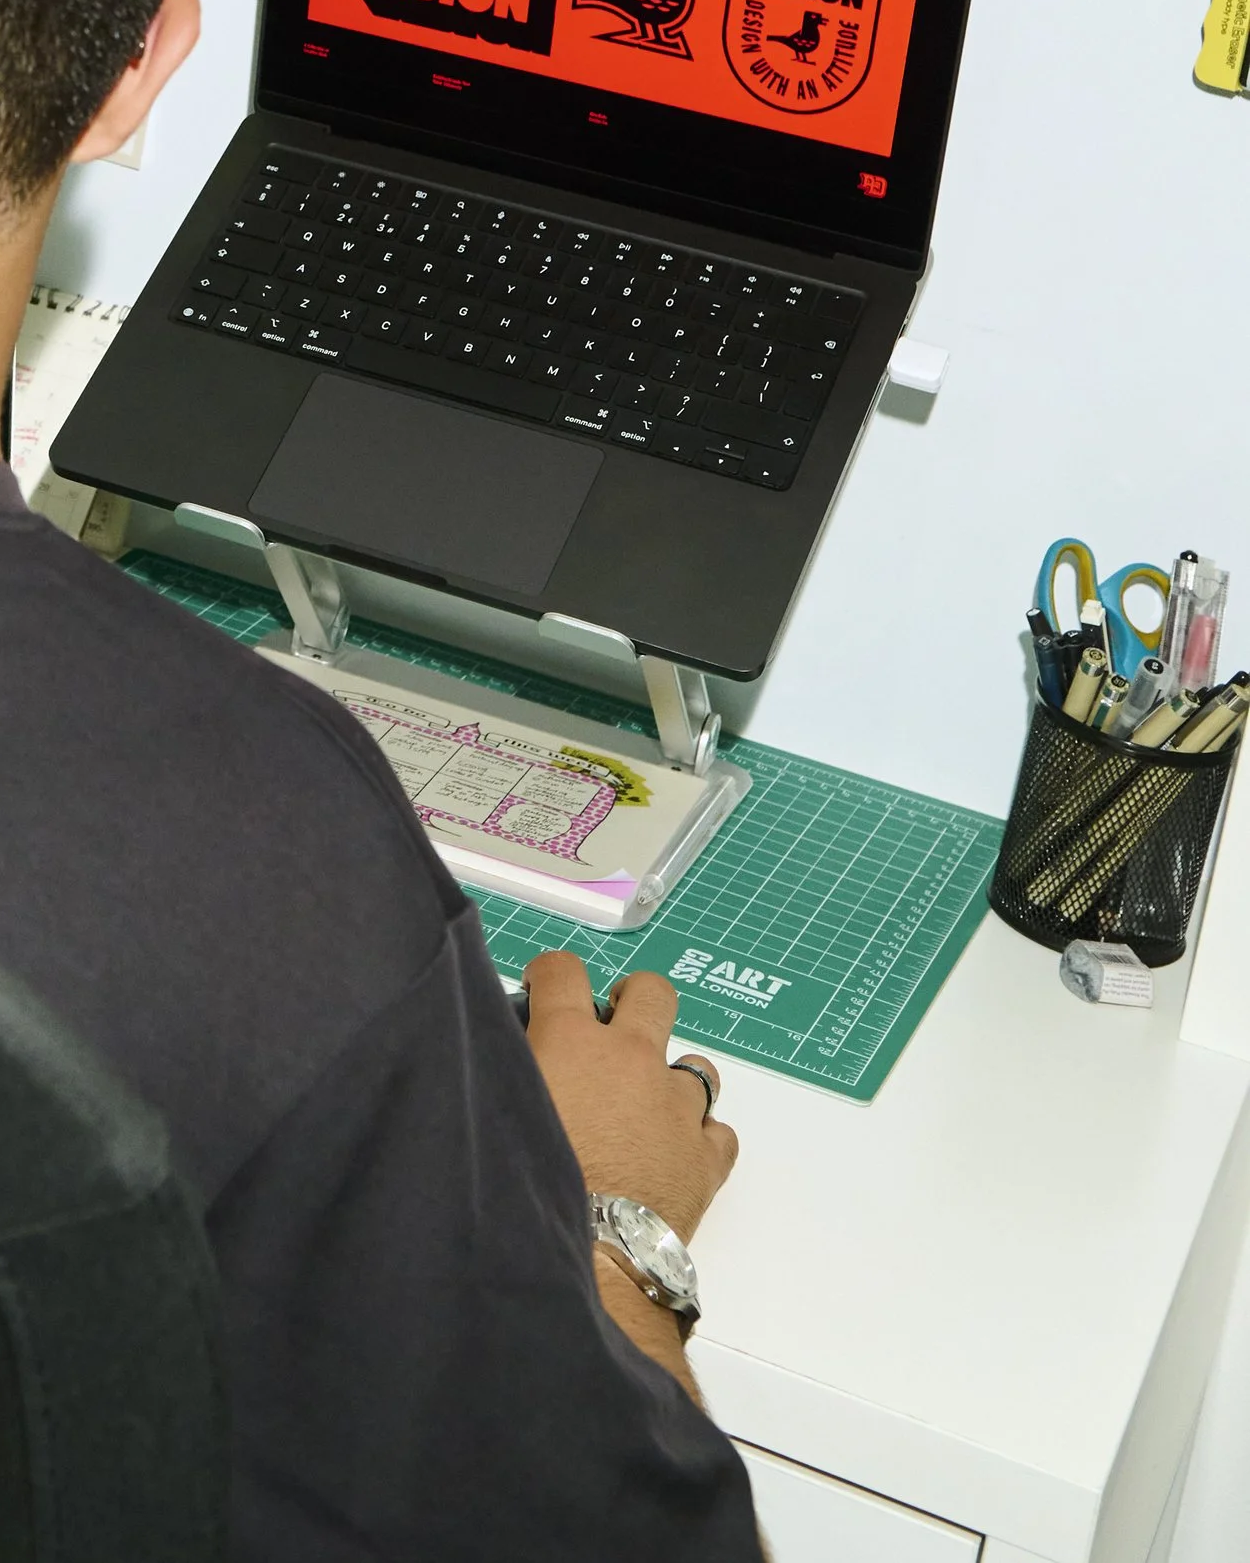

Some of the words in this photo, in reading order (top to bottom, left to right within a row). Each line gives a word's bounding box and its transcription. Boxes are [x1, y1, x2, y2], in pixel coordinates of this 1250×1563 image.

[1226, 26, 1245, 70] Eraser
[749, 57, 790, 97] WITH
[797, 78, 819, 100] AN
[821, 19, 860, 92] ATTITUDE
[222, 319, 248, 333] control
[262, 331, 285, 344] option
[302, 342, 338, 357] command
[564, 413, 603, 431] command
[620, 429, 646, 443] option
[710, 961, 793, 996] ART
[700, 981, 769, 1010] LONDON
